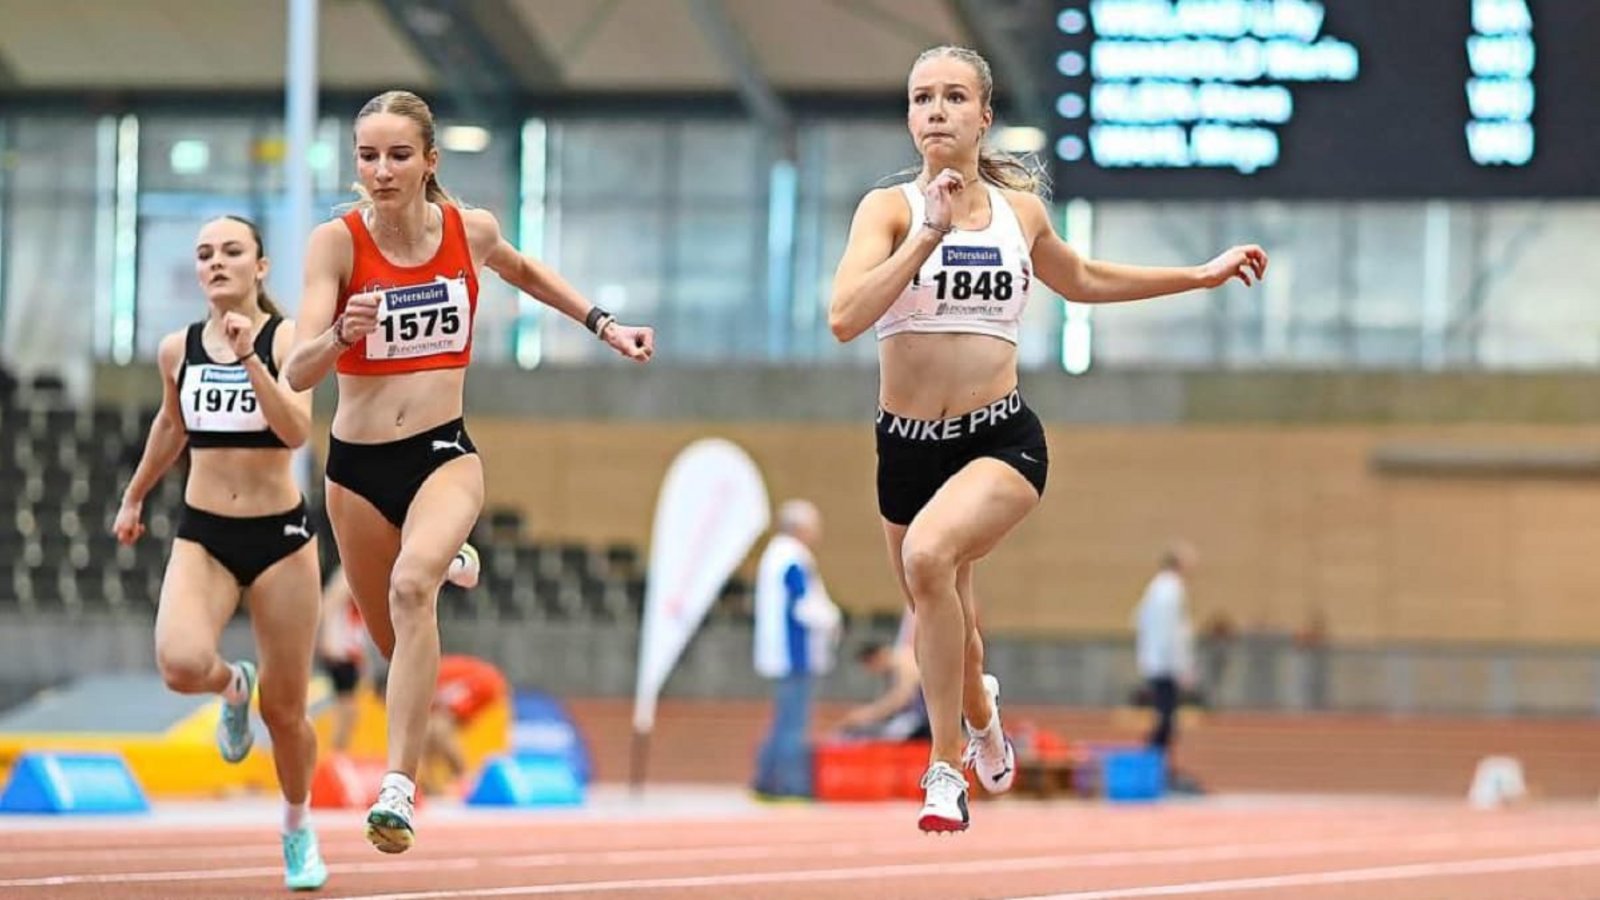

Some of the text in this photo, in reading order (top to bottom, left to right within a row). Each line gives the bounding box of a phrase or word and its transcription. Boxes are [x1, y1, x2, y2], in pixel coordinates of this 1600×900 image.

[390, 287, 445, 306] Peterstaler
[933, 271, 1013, 300] 1848
[380, 306, 460, 342] 1575
[192, 388, 257, 413] 1975
[888, 389, 1021, 441] NIKE PRO
